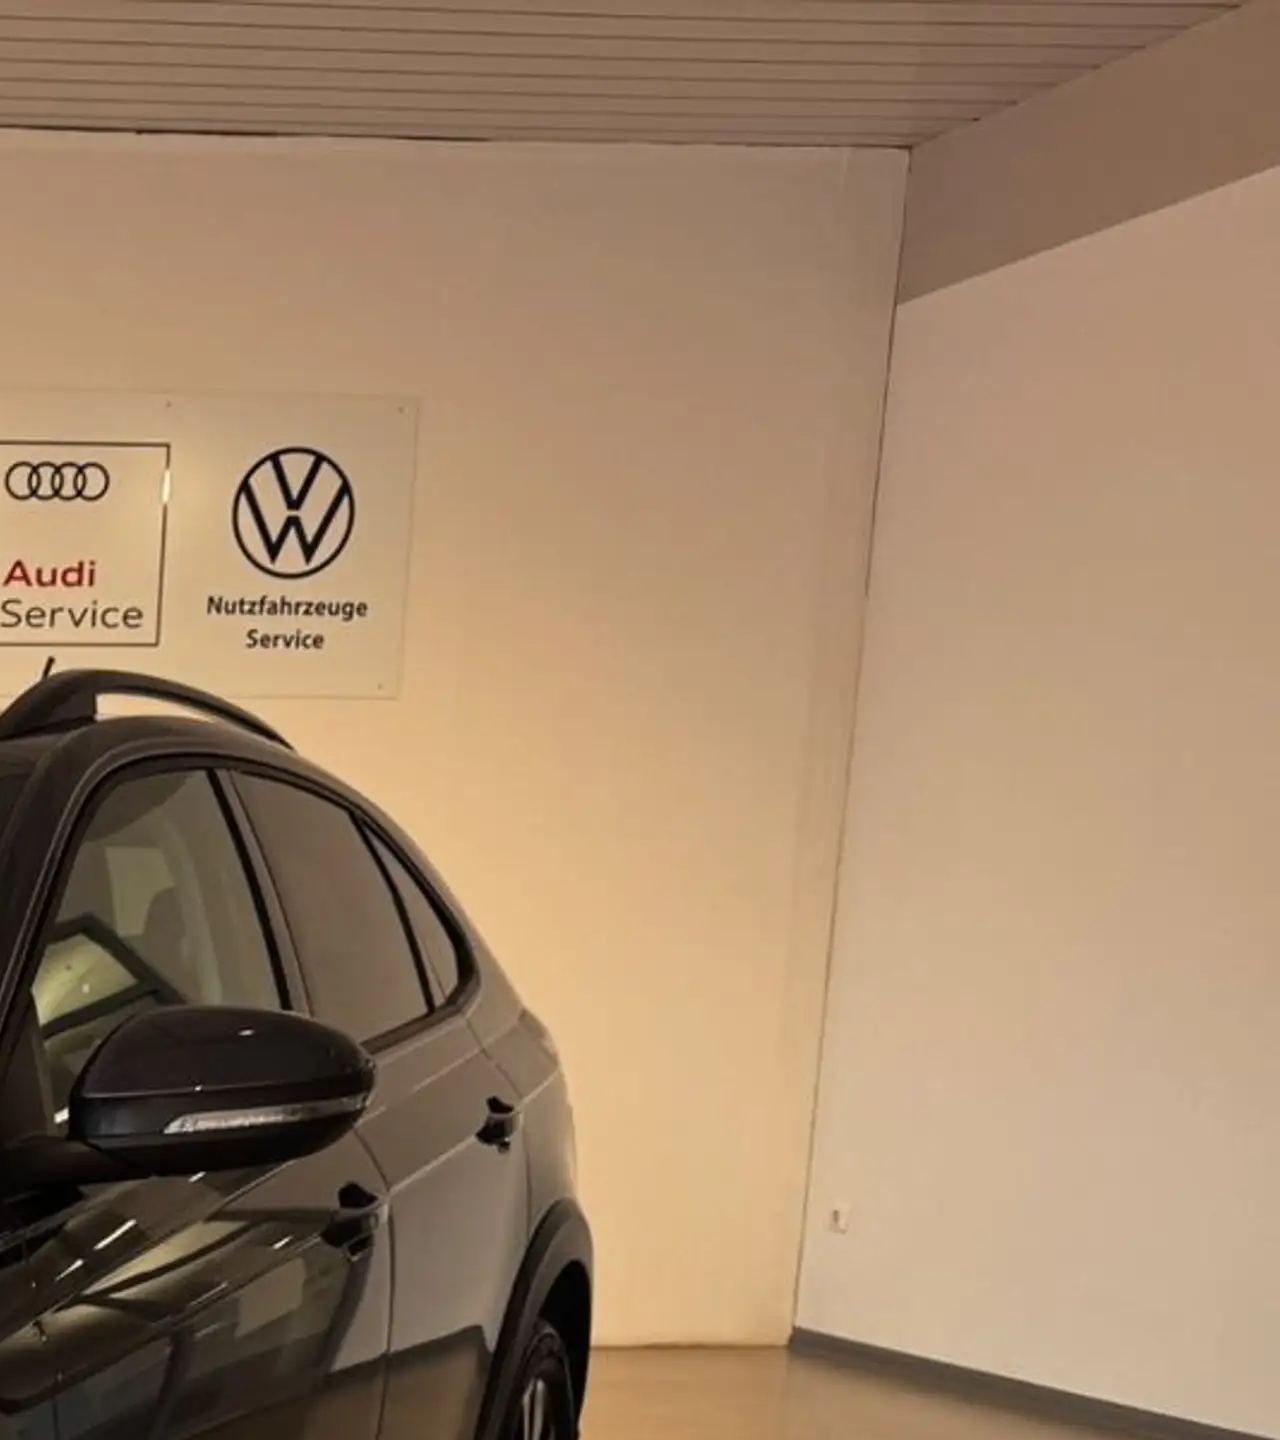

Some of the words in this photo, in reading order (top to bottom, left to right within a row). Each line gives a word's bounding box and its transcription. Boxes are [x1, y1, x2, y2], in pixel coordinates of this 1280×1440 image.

[2, 559, 97, 588] Audi
[205, 595, 368, 621] Nutzfahrzeuge
[244, 629, 325, 650] Service
